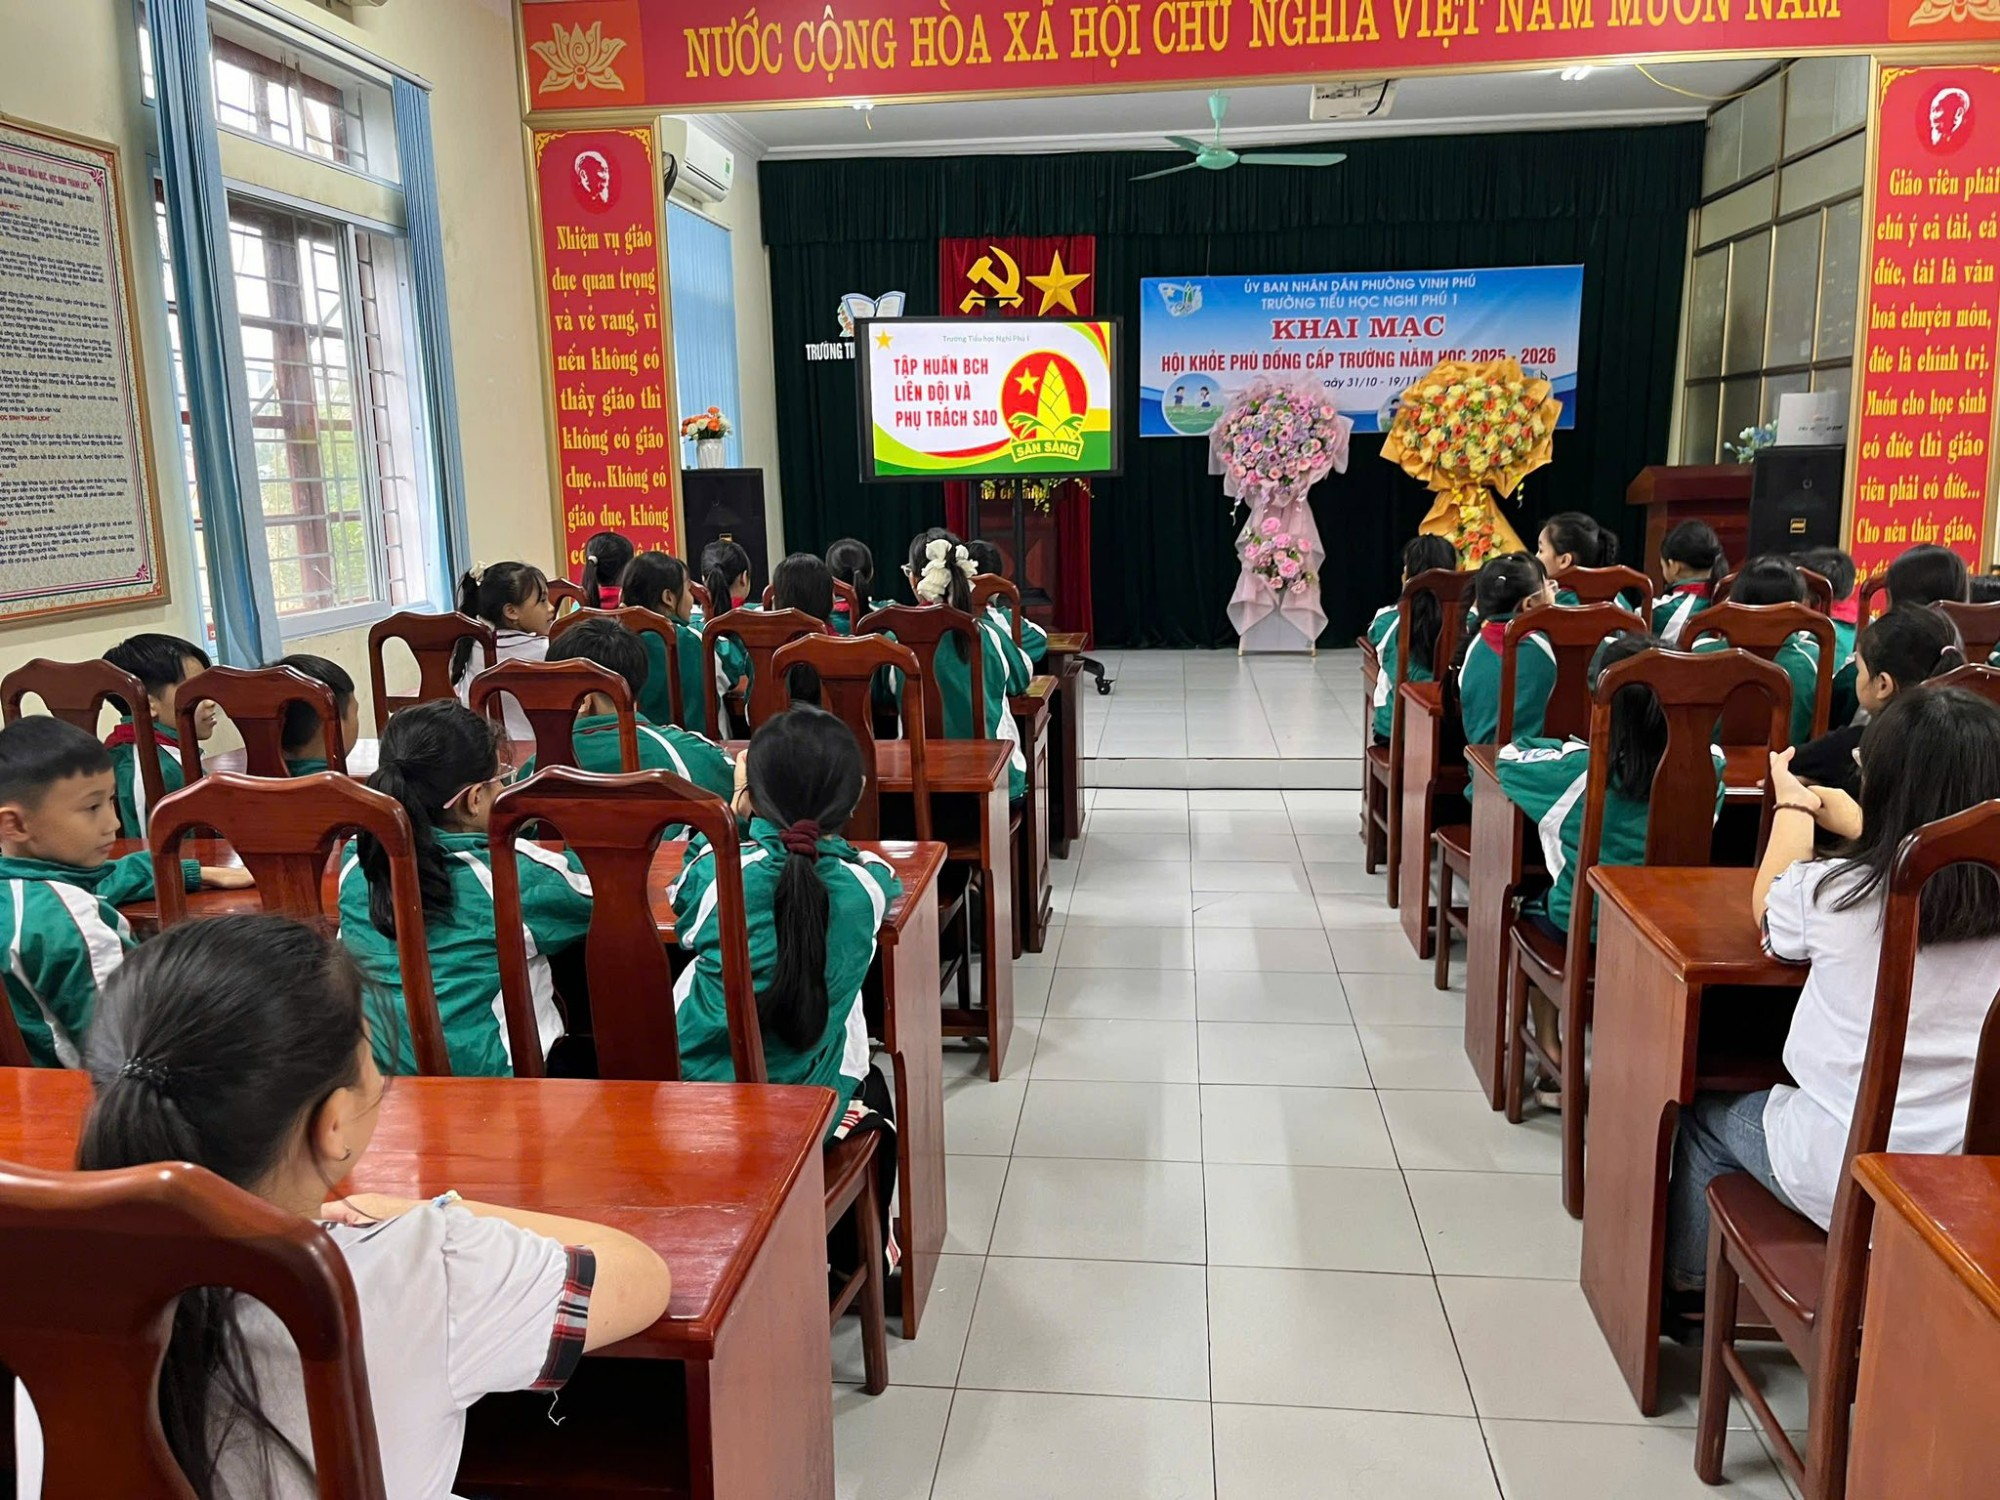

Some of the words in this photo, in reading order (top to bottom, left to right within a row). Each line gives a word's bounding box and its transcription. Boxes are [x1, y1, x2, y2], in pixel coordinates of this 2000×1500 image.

[683, 7, 783, 78] NƯỚC
[793, 4, 897, 83] CỘNG
[910, 0, 991, 67] HÒA
[1070, 0, 1141, 68] HỘI
[1495, 0, 1594, 33] NAM
[1889, 167, 1923, 196] Giáo
[1928, 168, 1959, 195] viên
[1964, 166, 2000, 203] phải
[556, 226, 599, 257] Nhiệm
[604, 232, 620, 256] vụ
[625, 224, 652, 255] giáo
[1877, 212, 1903, 240] chú
[1908, 213, 1918, 249] ý
[1923, 213, 1940, 240] cả
[1946, 212, 1972, 243] tài,
[1979, 211, 1997, 239] cả
[552, 266, 577, 298] dục
[582, 273, 616, 297] quan
[620, 266, 656, 296] trọng
[1263, 281, 1288, 293] BAN
[1291, 278, 1328, 293] NHÂN
[1333, 276, 1358, 292] DÂN
[1419, 277, 1449, 289] VINH
[1452, 273, 1476, 288] PHÚ
[1874, 257, 1906, 288] đức,
[1913, 257, 1935, 285] tài
[1940, 256, 1957, 284] là
[1963, 259, 1994, 283] văn
[1349, 296, 1379, 311] HỌC
[1383, 295, 1417, 308] NGHI
[1422, 291, 1447, 307] PHÚ
[555, 308, 573, 331] và
[578, 305, 596, 331] vẻ
[601, 309, 639, 337] vang,
[644, 303, 657, 328] vì
[1271, 317, 1359, 340] KHAI
[1368, 315, 1445, 343] MẠC
[1871, 302, 1896, 330] hoá
[1901, 301, 1951, 337] chuyên
[1956, 301, 1991, 330] môn,
[558, 343, 586, 371] nếu
[591, 347, 639, 377] không
[643, 346, 660, 369] có
[893, 354, 918, 379] TẬP
[923, 354, 958, 375] HUẤN
[963, 358, 989, 375] BCH
[1161, 352, 1185, 376] HỘI
[1189, 349, 1226, 371] KHỎE
[1306, 346, 1334, 369] CẤP
[1399, 347, 1433, 367] NĂM
[1520, 347, 1556, 364] 2026
[1868, 345, 1893, 373] đức
[1898, 345, 1912, 373] là
[1917, 345, 1958, 372] chính
[1965, 344, 1989, 379] trị.
[894, 380, 922, 402] LIÊN
[928, 381, 949, 404] ĐỘI
[954, 380, 971, 401] VÀ
[1346, 376, 1378, 388] 31/10
[560, 382, 596, 417] thầy
[602, 386, 635, 417] giáo
[641, 384, 662, 409] thì
[1865, 386, 1897, 416] Muốn
[1902, 389, 1925, 416] cho
[1929, 389, 1953, 422] học
[1958, 387, 1986, 414] sinh
[895, 410, 921, 431] PHỤ
[926, 406, 968, 427] TRÁCH
[973, 409, 998, 426] SAO
[562, 427, 608, 456] không
[614, 426, 630, 448] có
[635, 426, 664, 456] giáo
[1862, 433, 1880, 460] có
[1886, 431, 1913, 459] đức
[1919, 430, 1942, 458] thì
[1947, 430, 1984, 465] giáo
[653, 465, 667, 488] có
[1859, 477, 1885, 502] viên
[1889, 474, 1919, 508] phải
[1923, 474, 1938, 500] có
[568, 504, 596, 533] giáo
[600, 504, 626, 532] dục,
[630, 504, 670, 533] không
[1856, 517, 1880, 544] Cho
[1884, 518, 1907, 543] nên
[1911, 511, 1940, 545] thầy
[1943, 516, 1976, 548] giáo,
